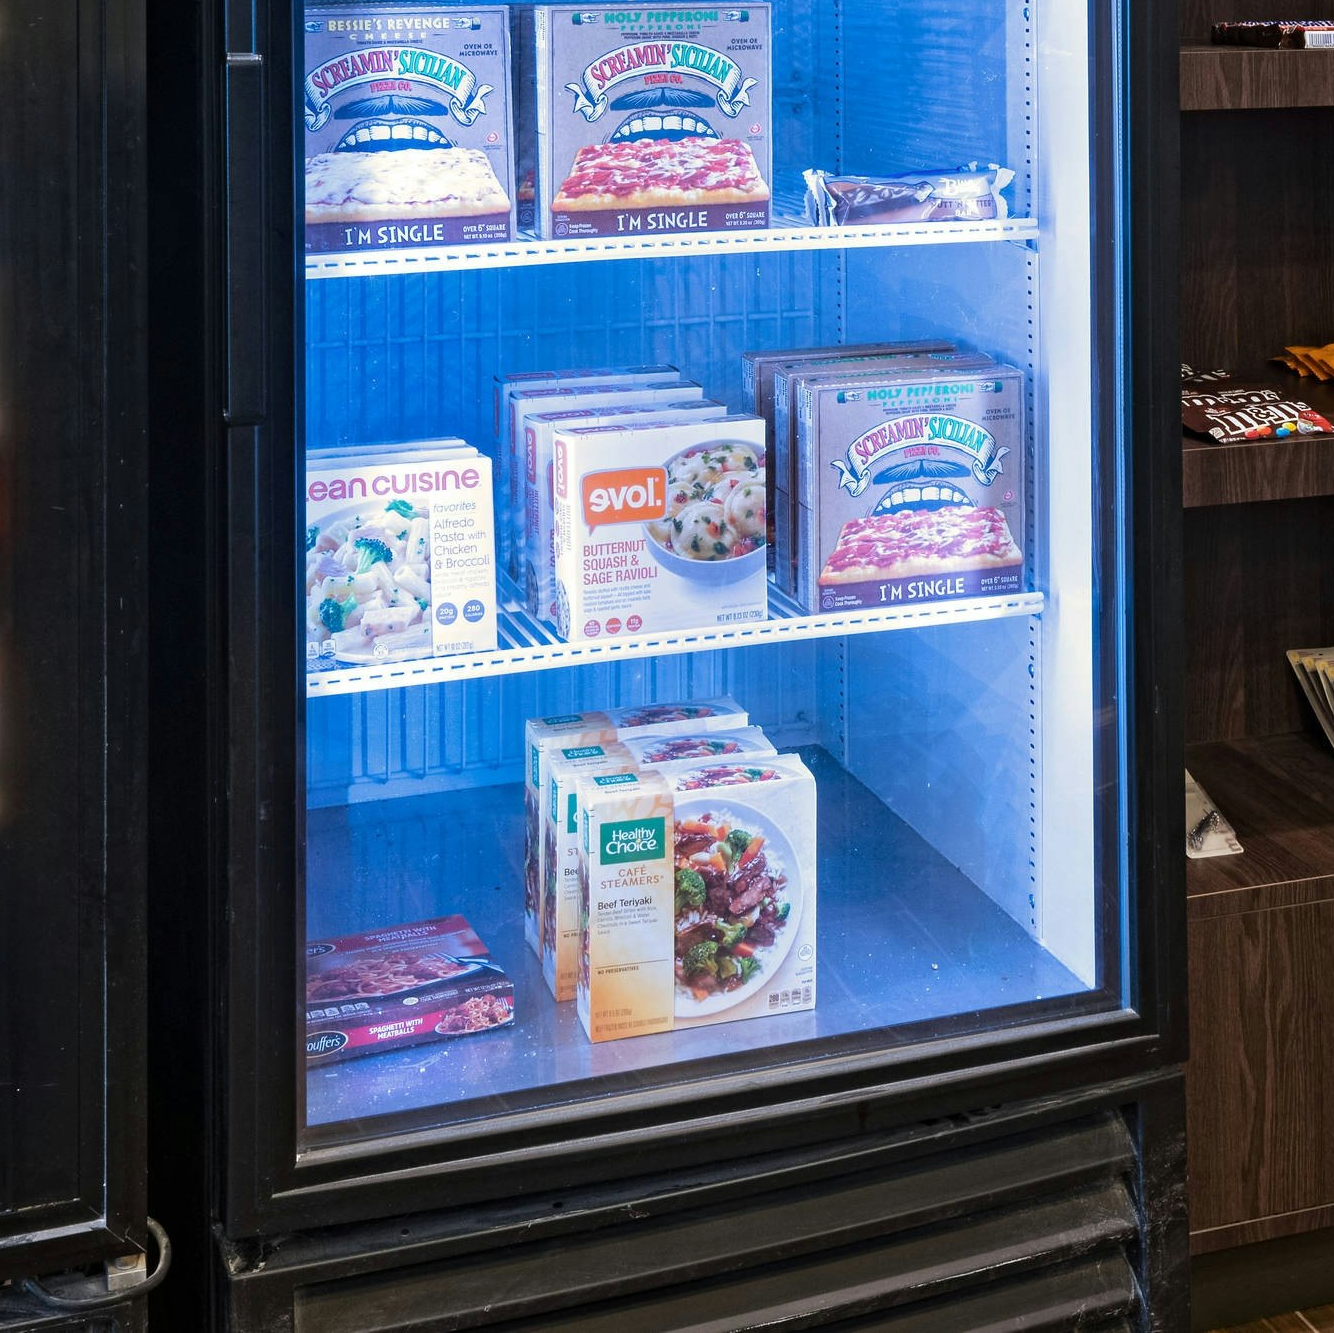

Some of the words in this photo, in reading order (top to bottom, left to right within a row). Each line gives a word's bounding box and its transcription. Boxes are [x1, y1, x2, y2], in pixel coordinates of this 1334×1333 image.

[328, 18, 383, 33] BESSIE'S
[387, 17, 450, 31] REVENGE
[604, 11, 641, 23] HOLY
[647, 10, 718, 22] PEPPERONI
[463, 43, 481, 51] OVEN
[311, 49, 399, 97] SCREAMIN'
[398, 49, 466, 90] SICILIAN
[590, 44, 672, 89] SCREAMIN'
[670, 44, 734, 83] SICILIAN
[617, 212, 642, 231] I'M
[647, 211, 708, 229] SINGLE
[345, 226, 371, 246] I'M
[377, 224, 445, 245] SINGLE
[927, 417, 988, 454] SICILIAN
[308, 477, 367, 502] ean
[371, 468, 480, 496] cuisine
[433, 500, 476, 513] favorites
[433, 517, 475, 530] Alfredo
[433, 531, 466, 543] Pasta
[467, 529, 487, 541] with
[433, 543, 478, 556] Chicken
[583, 539, 646, 557] BUTTERNUT
[434, 559, 443, 570] &
[446, 554, 490, 569] Broccoli
[583, 554, 628, 571] SQUASH
[630, 554, 639, 566] &
[583, 571, 613, 586] SAGE
[615, 566, 658, 582] RAVIOLI
[879, 584, 903, 603] I'M
[907, 578, 965, 600] SINGLE
[612, 825, 656, 843] Healthy
[605, 837, 658, 855] Choice
[618, 865, 647, 878] CAFÉ
[600, 875, 660, 889] STEAMERS
[597, 900, 618, 911] Beef
[619, 896, 652, 909] Teriyaki
[369, 1022, 405, 1035] SPAGHETTI
[405, 1017, 423, 1028] WITH
[377, 1026, 415, 1039] MEATBALLS
